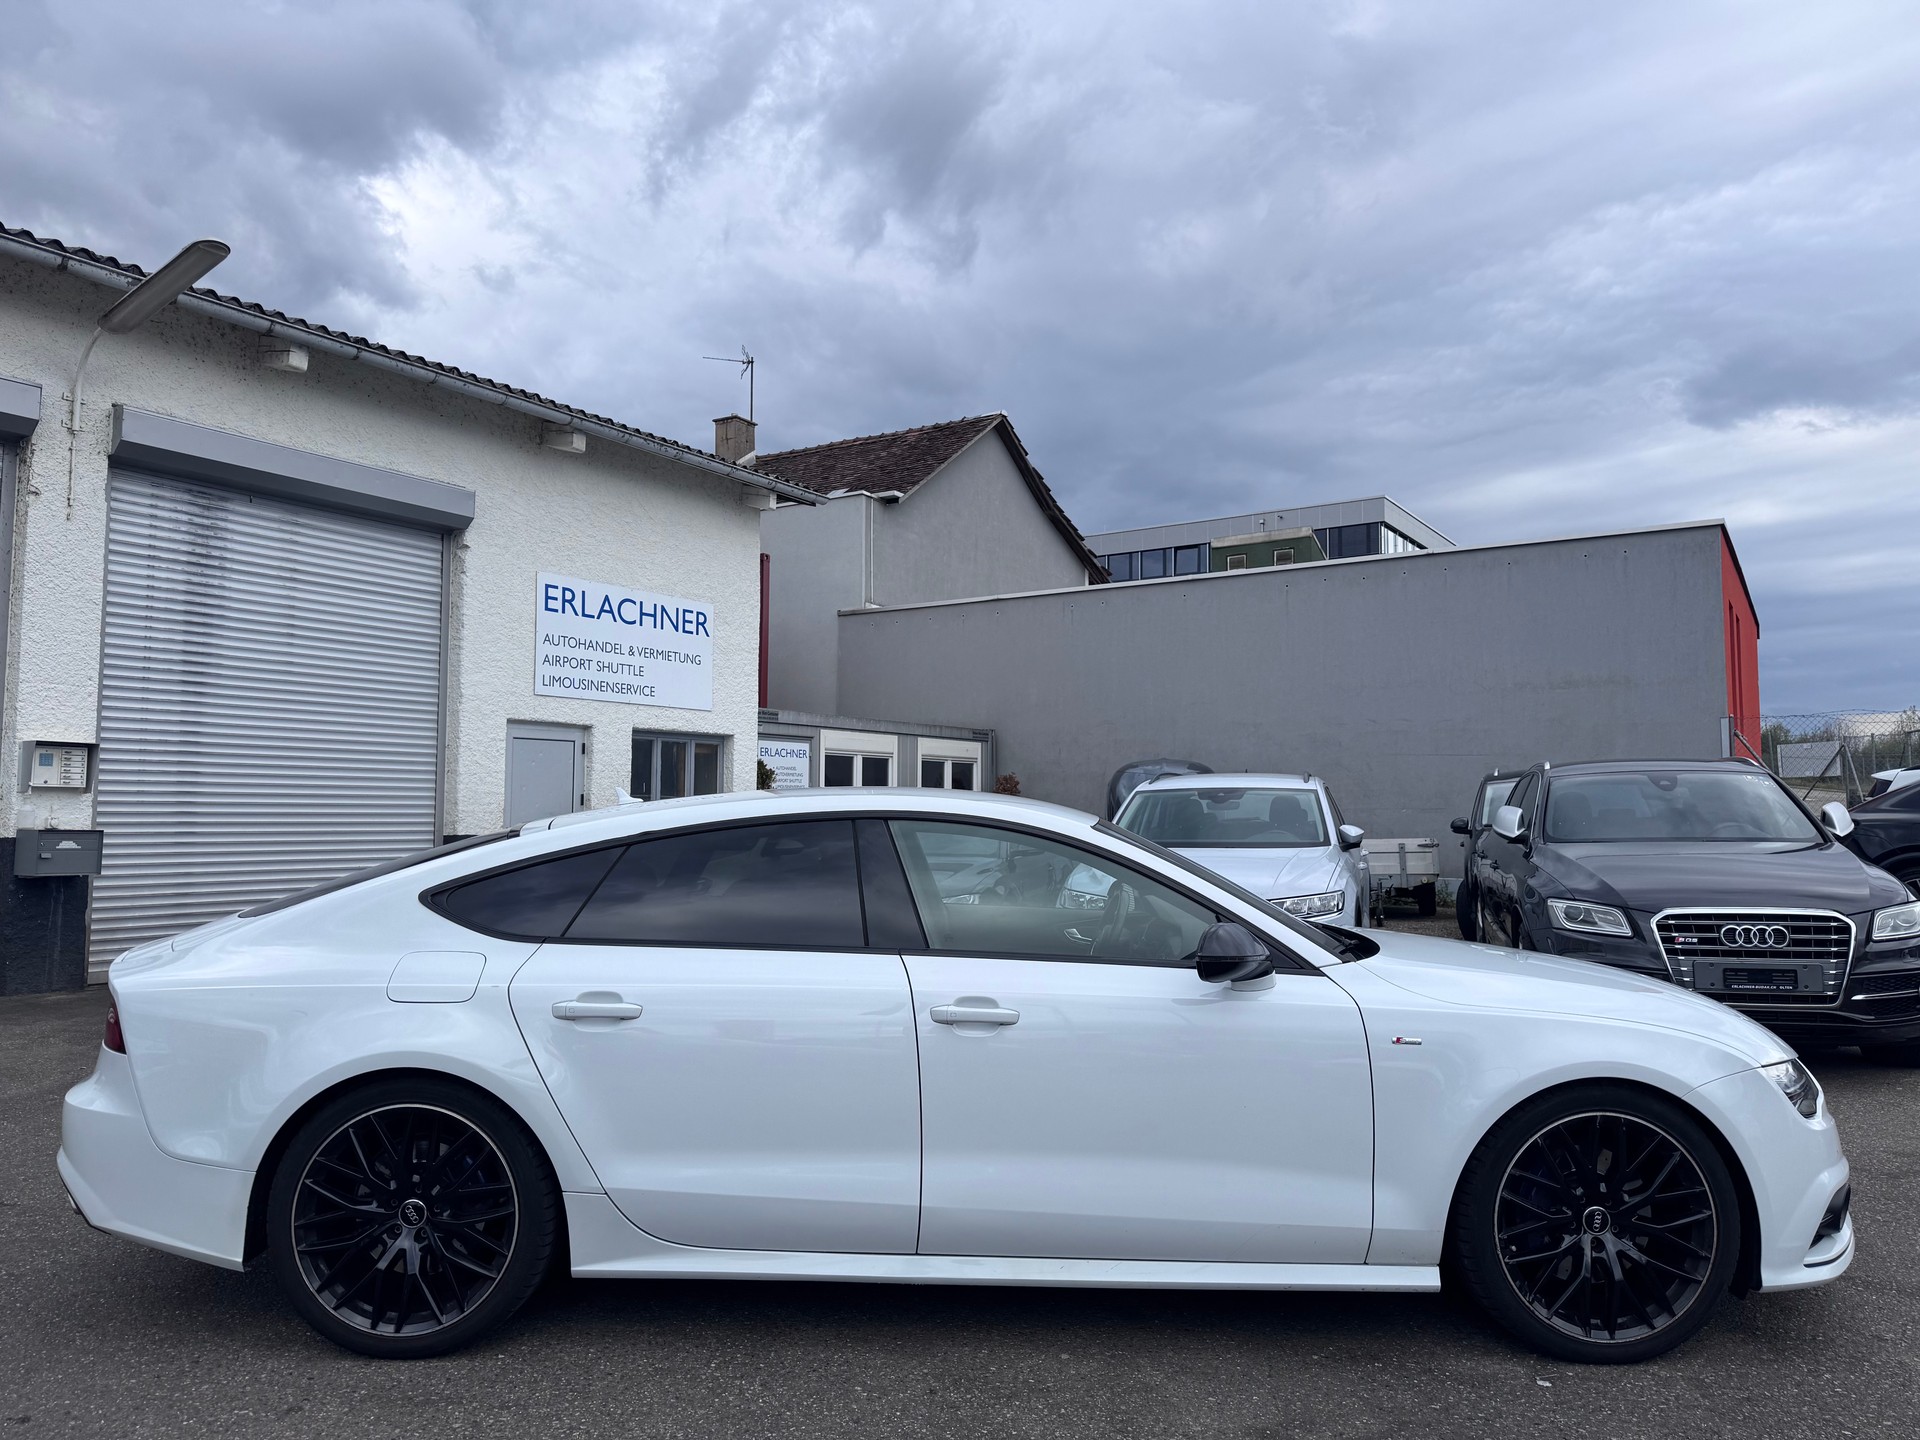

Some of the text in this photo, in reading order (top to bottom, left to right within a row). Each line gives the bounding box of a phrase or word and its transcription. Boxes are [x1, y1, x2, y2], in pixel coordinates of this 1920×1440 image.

[544, 583, 710, 637] ERLACHNER
[542, 633, 702, 666] AUTOHANDEL & VERMIETUNG
[542, 653, 645, 677] AIRPORT SHUTTLE
[542, 674, 656, 697] LIMOUSINENSERVICE
[760, 746, 808, 759] ERLACHNER
